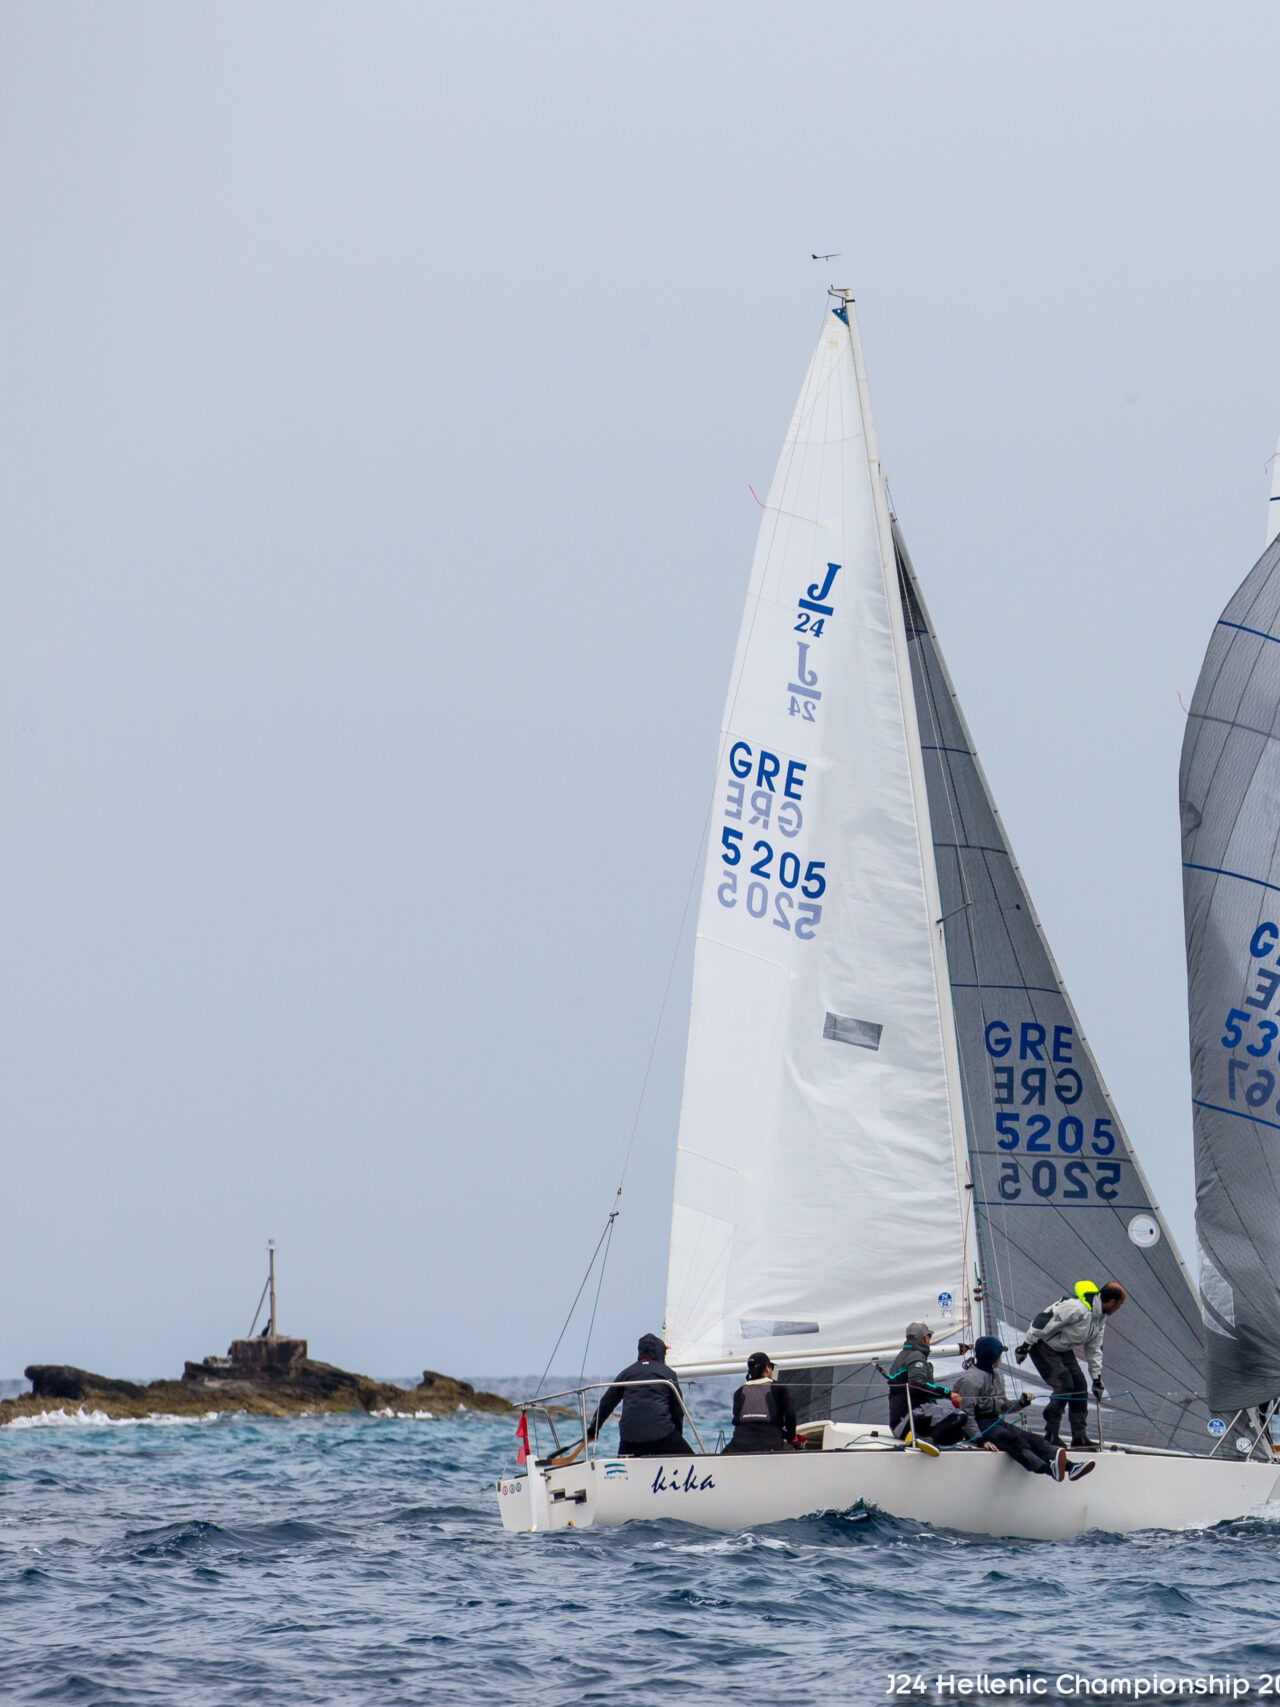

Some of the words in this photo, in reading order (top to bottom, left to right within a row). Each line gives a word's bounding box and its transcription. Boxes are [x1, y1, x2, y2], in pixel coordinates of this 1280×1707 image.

[807, 562, 842, 601] J
[793, 613, 825, 638] 24
[729, 741, 807, 801] GRE
[721, 826, 826, 899] 5205
[985, 1020, 1073, 1063] GRE
[996, 1112, 1115, 1155] 5205
[651, 1464, 716, 1494] kika
